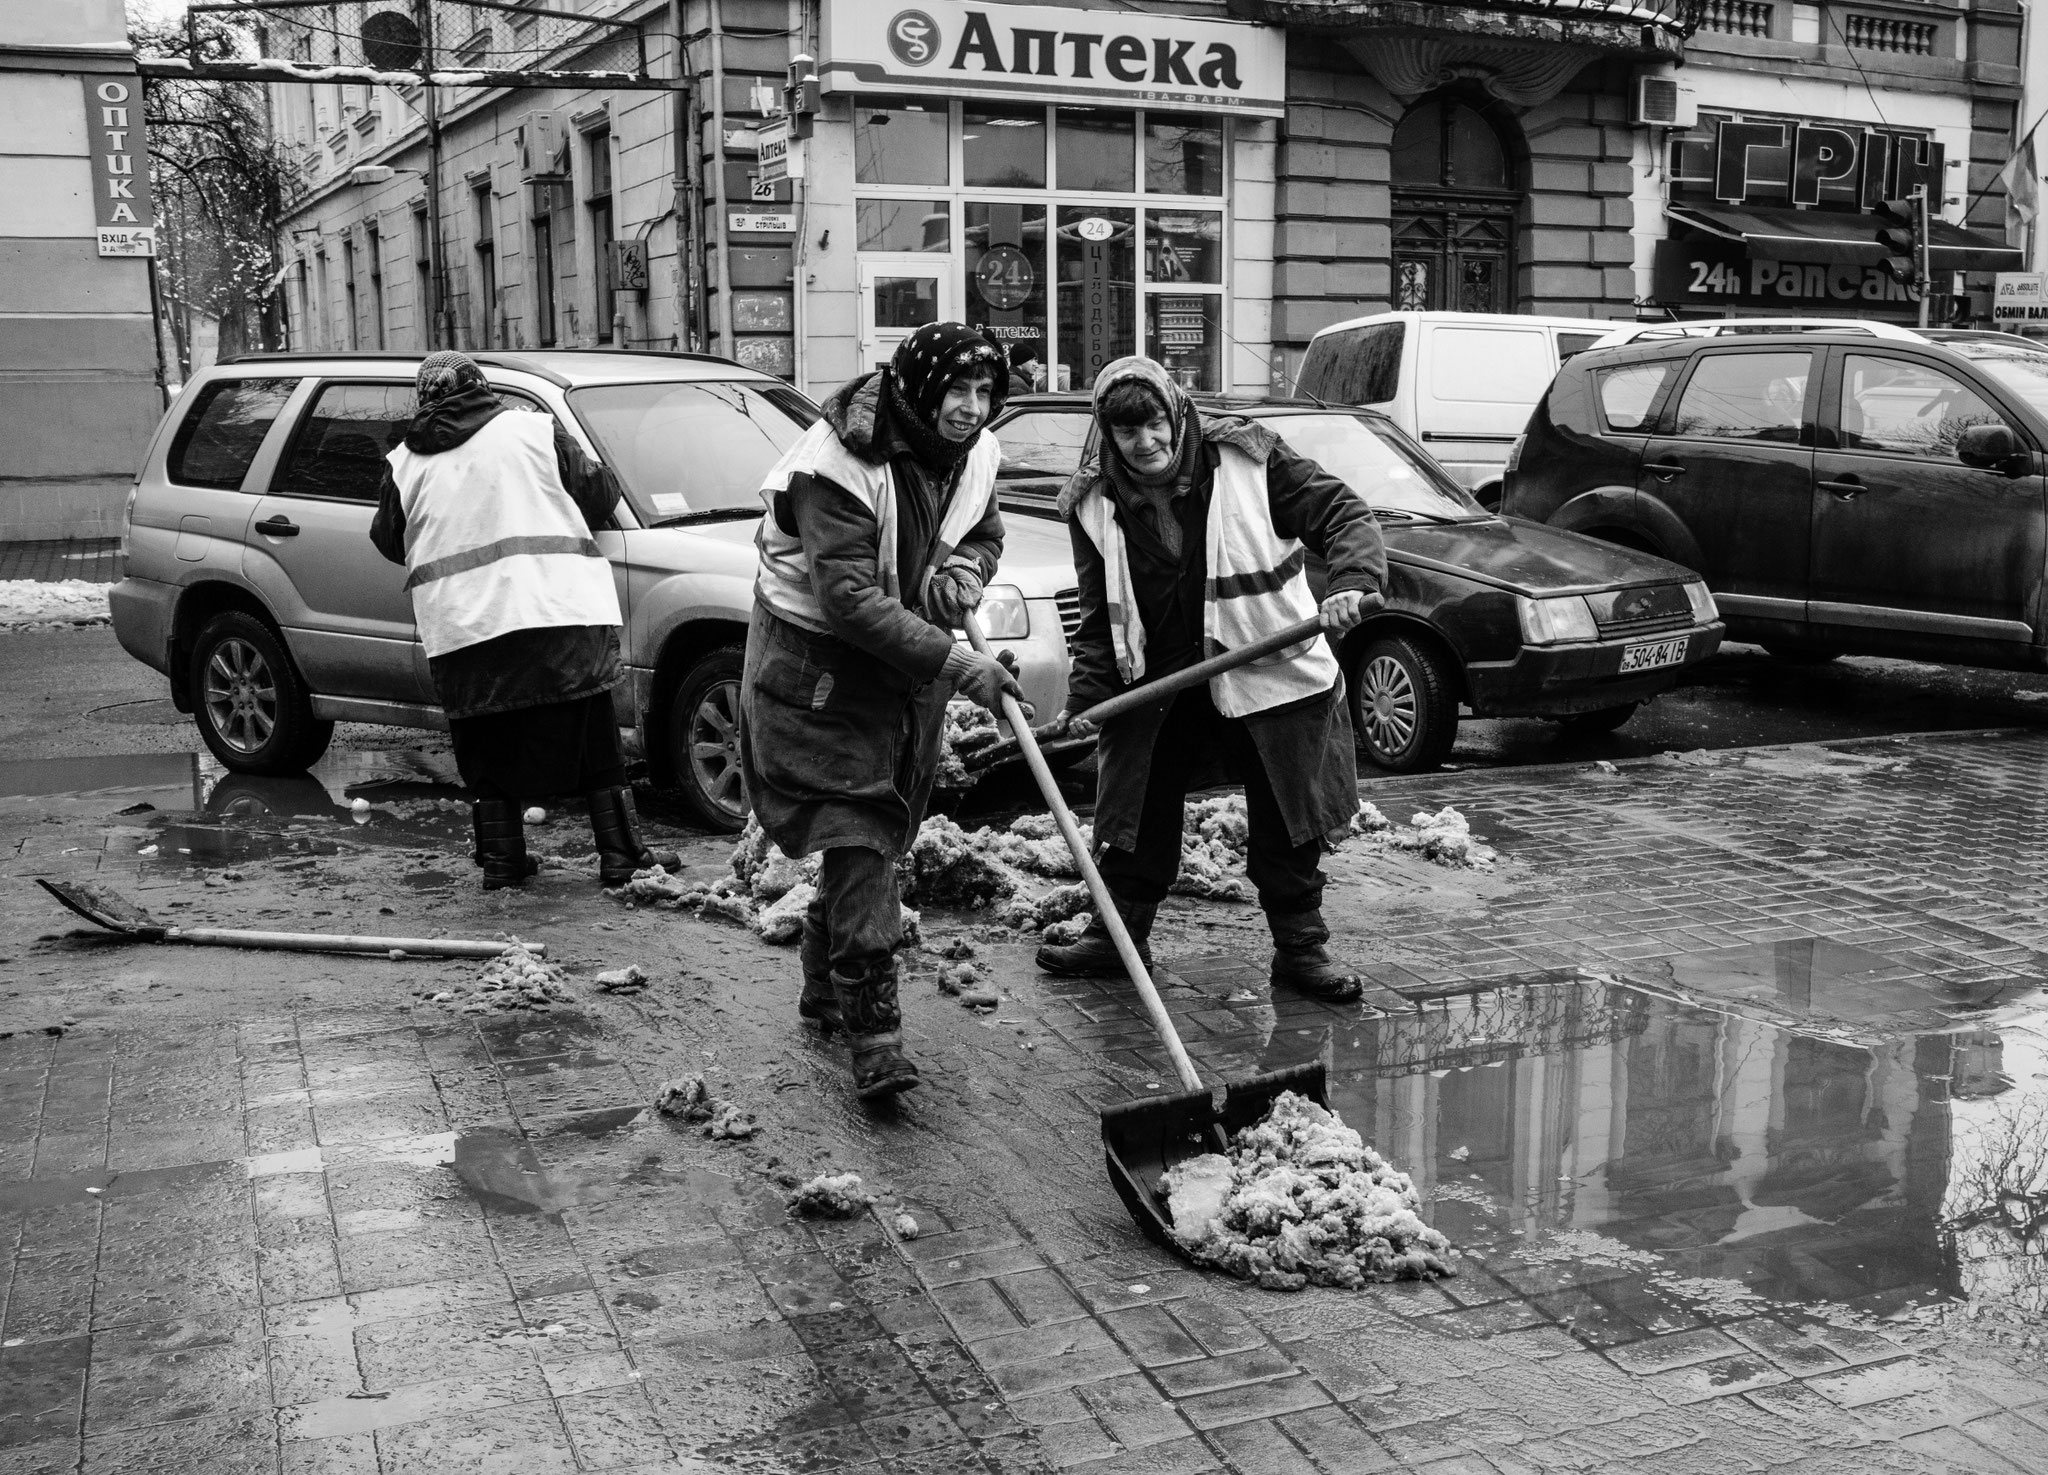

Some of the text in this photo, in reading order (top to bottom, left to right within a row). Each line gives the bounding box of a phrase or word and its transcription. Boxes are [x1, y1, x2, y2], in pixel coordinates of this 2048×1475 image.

[949, 10, 1243, 90] Аптека
[97, 82, 139, 223] ОПТИКА
[760, 138, 786, 162] Аптека
[1715, 120, 1945, 215] ГРІН
[753, 181, 772, 197] 26
[101, 233, 128, 243] ВХІД
[1086, 222, 1105, 236] 24
[987, 260, 1021, 286] 24
[1688, 258, 1921, 303] 24h PanCak
[1995, 306, 2025, 318] ОБМІН
